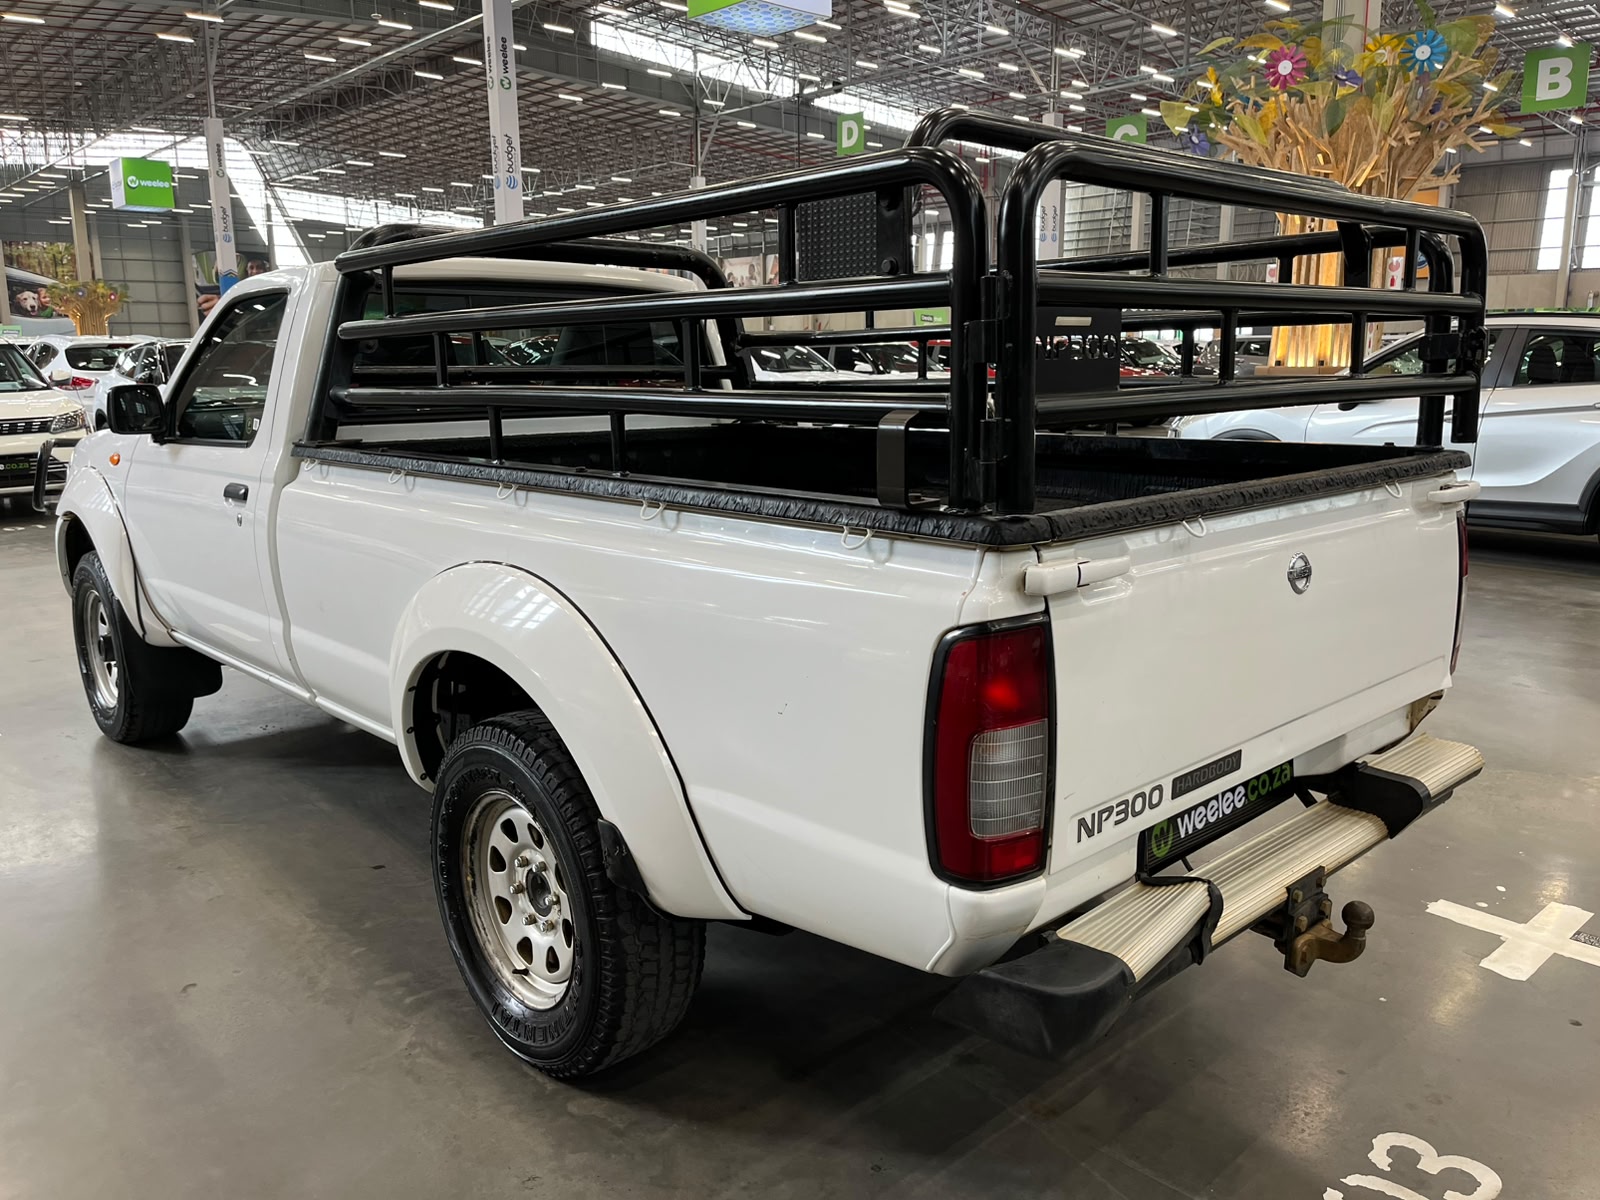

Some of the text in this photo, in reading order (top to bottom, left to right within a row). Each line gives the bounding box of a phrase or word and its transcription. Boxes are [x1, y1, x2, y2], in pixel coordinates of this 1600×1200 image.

[500, 37, 509, 74] weelee
[1536, 57, 1573, 101] B
[504, 133, 516, 173] budget
[842, 120, 858, 148] D
[140, 180, 170, 188] weelee
[1035, 335, 1117, 360] NP300
[1175, 754, 1241, 794] HARDBODY
[1077, 784, 1163, 843] NP300
